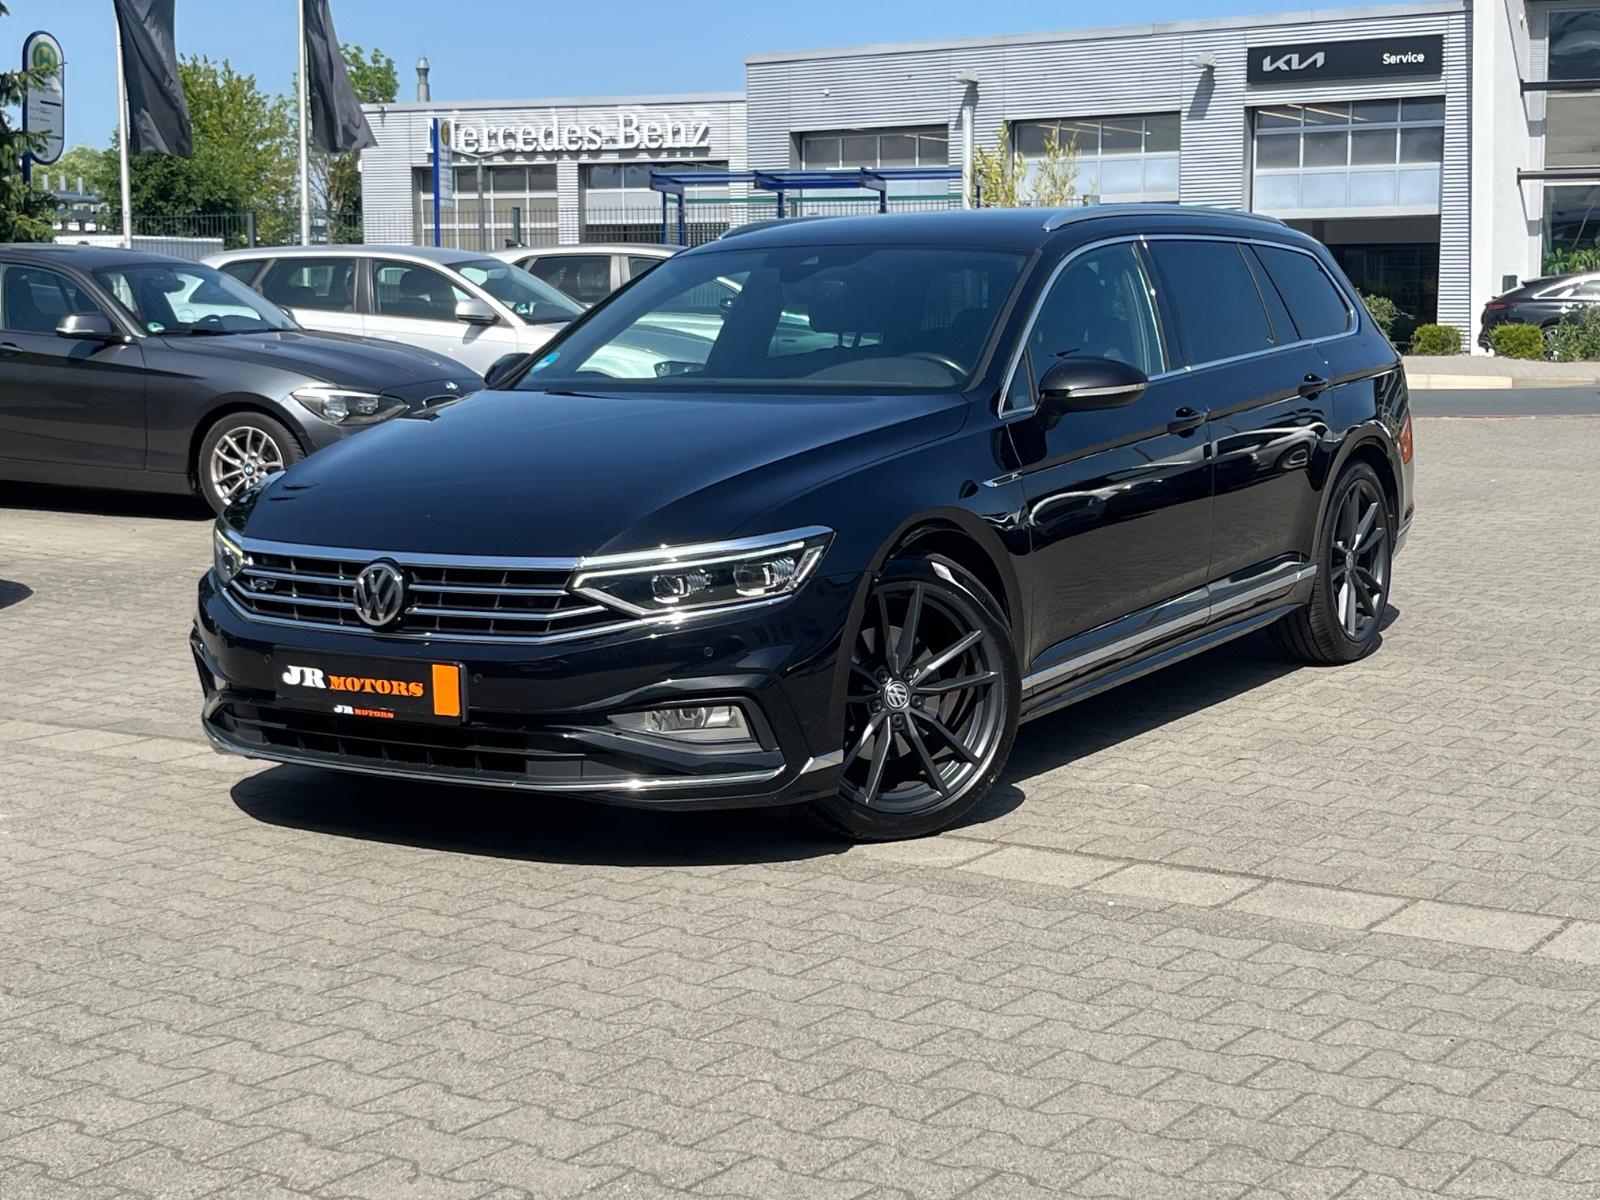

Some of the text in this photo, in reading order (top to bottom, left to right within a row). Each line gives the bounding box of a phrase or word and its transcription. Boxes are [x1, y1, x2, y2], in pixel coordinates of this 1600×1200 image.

[1382, 51, 1425, 64] Service
[282, 665, 424, 697] JR MOTORS
[333, 704, 395, 719] JR MOTORS
